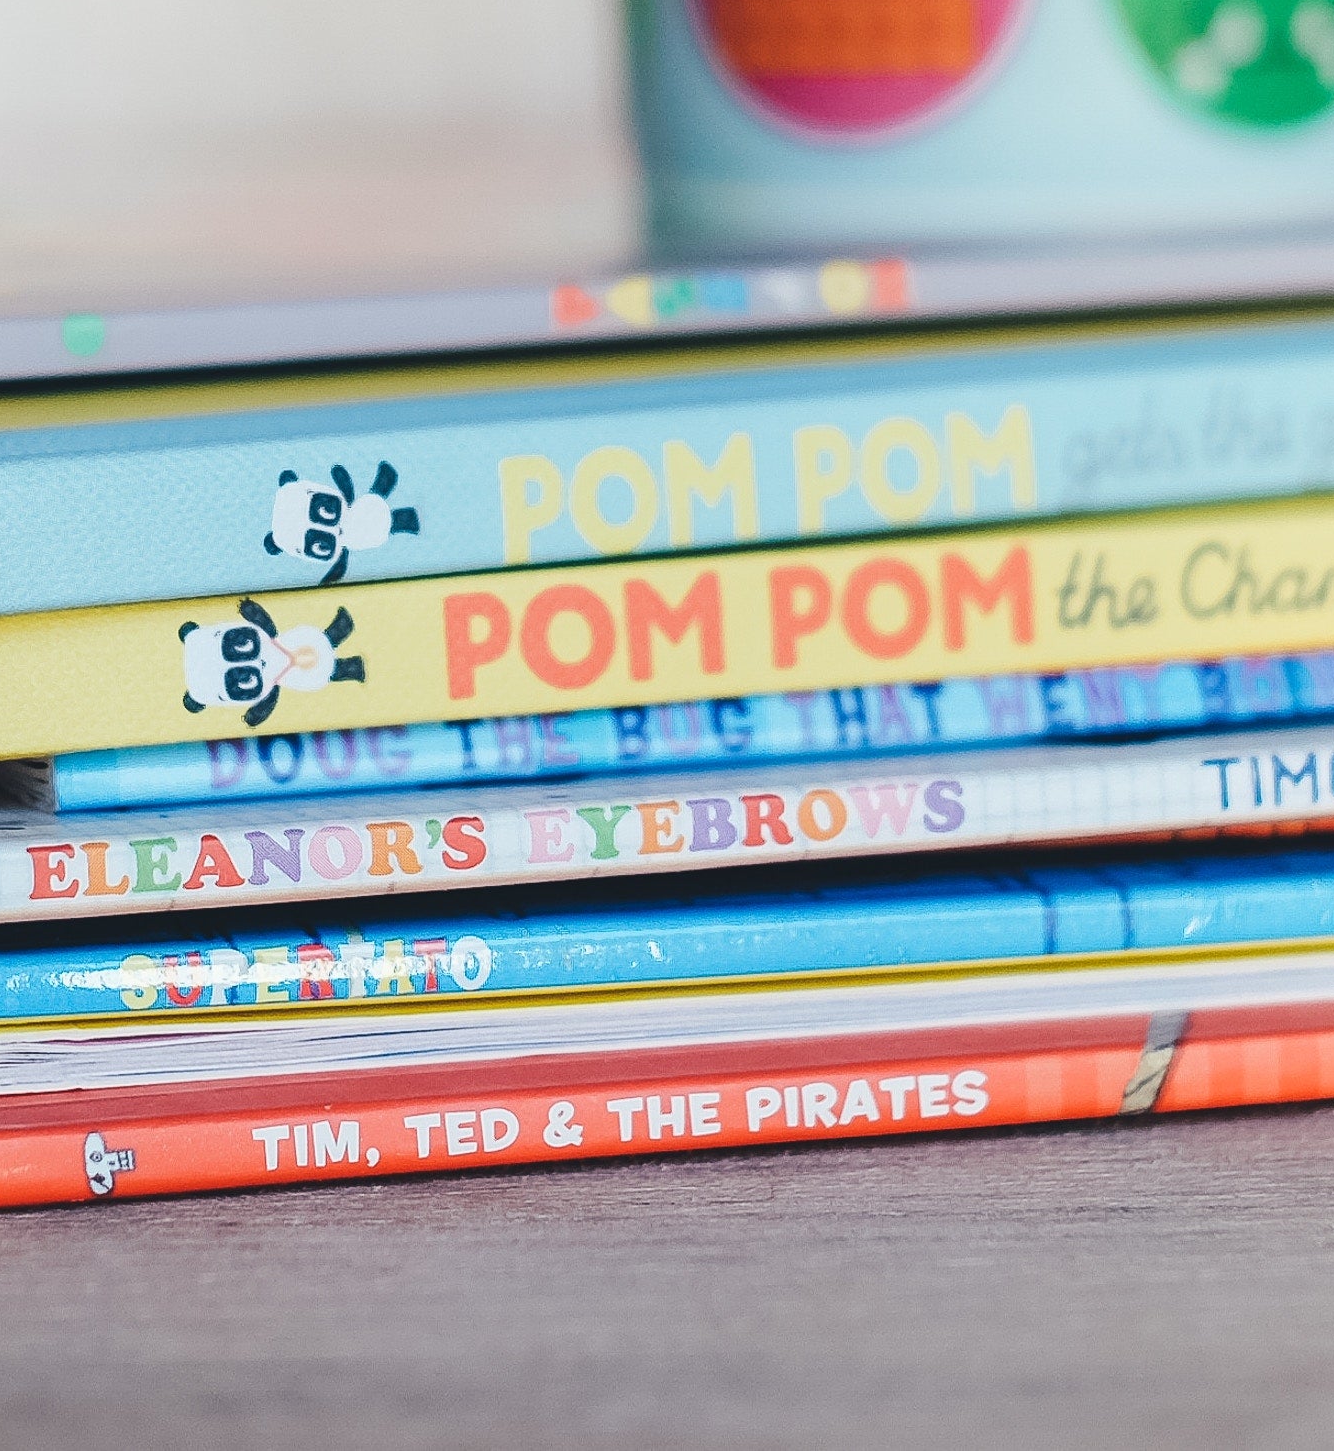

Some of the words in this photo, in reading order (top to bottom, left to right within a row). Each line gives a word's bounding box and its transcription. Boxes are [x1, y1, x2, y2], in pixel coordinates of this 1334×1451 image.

[499, 434, 758, 562] POM
[795, 407, 1037, 533] POM
[444, 571, 724, 698] POM
[771, 546, 1034, 669] POM
[1056, 552, 1157, 630] the
[207, 724, 410, 789] DOUG
[459, 713, 577, 772] THE
[617, 701, 753, 764] BUG
[781, 684, 942, 750] THAT
[983, 666, 1163, 732] WENT
[27, 817, 487, 899] ELEANOR'S
[526, 781, 964, 861] EYEBROWS
[120, 936, 490, 1008] SUPERTATO
[253, 1121, 379, 1169] TIM,
[406, 1109, 519, 1157] TED
[544, 1101, 583, 1147] &
[608, 1091, 721, 1141] THE
[748, 1070, 988, 1131] PIRATES
